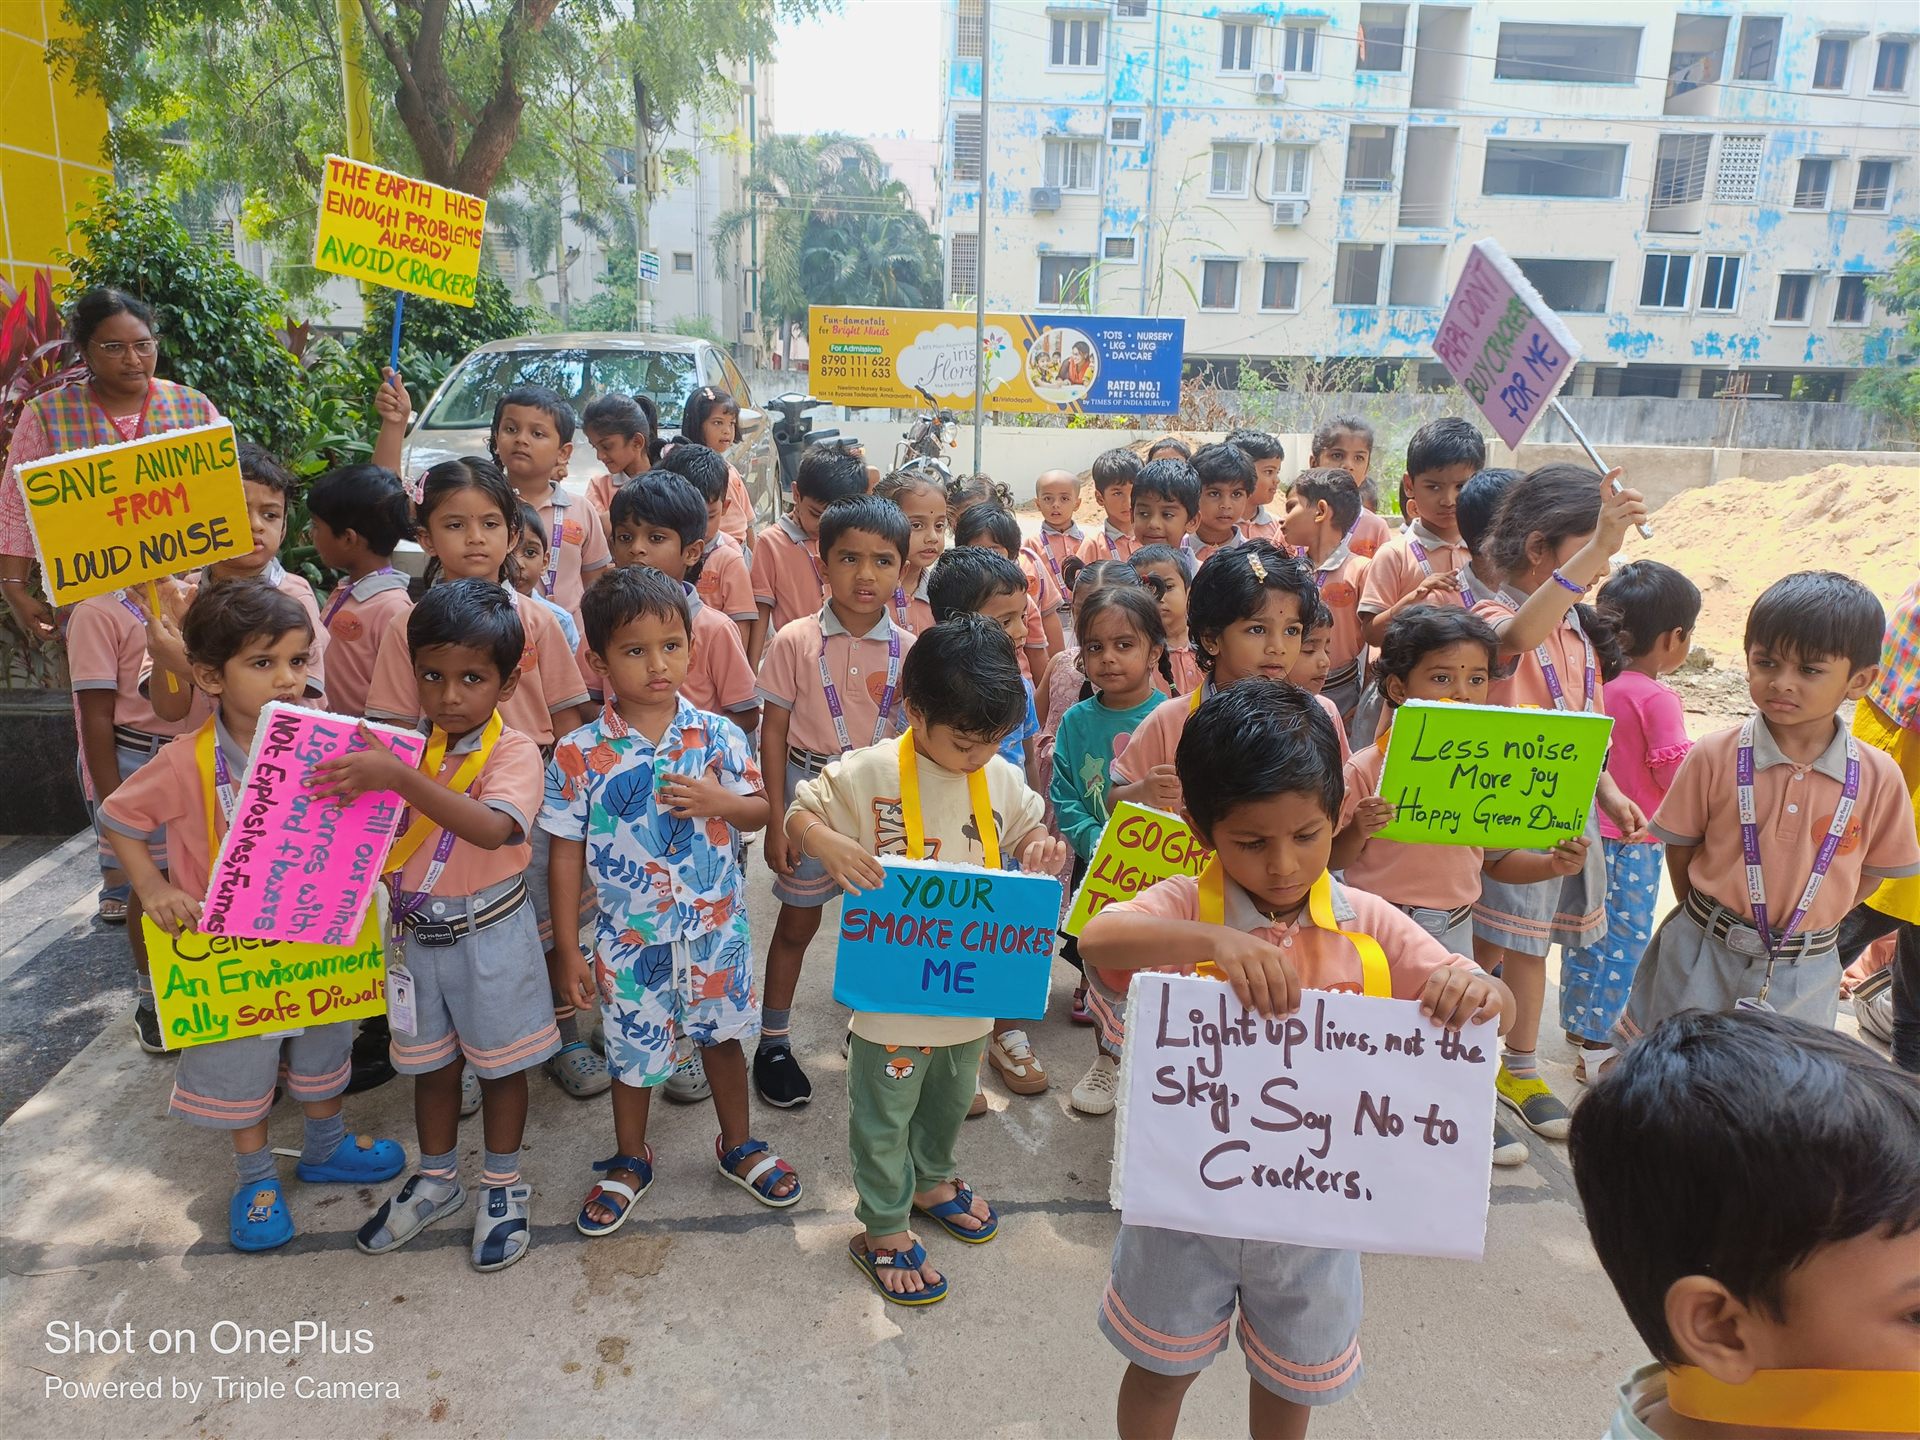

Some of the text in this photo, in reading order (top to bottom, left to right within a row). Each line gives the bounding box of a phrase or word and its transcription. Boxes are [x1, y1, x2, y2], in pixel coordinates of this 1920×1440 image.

[329, 160, 482, 222] THE EARTH HAS
[326, 190, 482, 249] ENOUGH PROBLEMS
[321, 235, 477, 298] AVOID CRACKERS
[378, 229, 452, 261] ALREADY
[832, 325, 860, 337] Bright
[864, 326, 889, 336] Minds
[843, 345, 882, 353] Admissions
[953, 346, 977, 361] iris
[1103, 331, 1173, 341] TOTS NURSERY
[1109, 341, 1156, 350] LKG UKG
[1439, 320, 1474, 372] PAPA
[821, 355, 891, 367] 8790 111 622
[821, 367, 891, 378] 8790 111 633
[1112, 351, 1152, 360] DAYCARE
[1500, 333, 1558, 424] FOR ME
[1107, 380, 1161, 391] RATED NO.1
[1464, 356, 1497, 405] BUY
[26, 437, 237, 506] SAVE ANIMALS
[107, 482, 190, 526] FROM
[55, 516, 233, 590] LOUD NOISE
[1410, 713, 1579, 762] Less noise,
[1449, 763, 1558, 798] More joy
[1395, 786, 1583, 835] Happy Green Diwali
[1116, 816, 1163, 852] GO
[286, 884, 324, 936] with
[897, 874, 995, 913] YOUR
[323, 889, 359, 945] minds
[841, 908, 1055, 958] SMOKE CHOKES
[163, 964, 210, 999] An
[921, 958, 977, 994] ME
[172, 1001, 229, 1042] ally
[307, 978, 385, 1017] Diwali
[1156, 983, 1486, 1077] Light up lives, not the
[1250, 1077, 1331, 1159] Say
[1354, 1090, 1405, 1138] No
[1414, 1103, 1459, 1145] to
